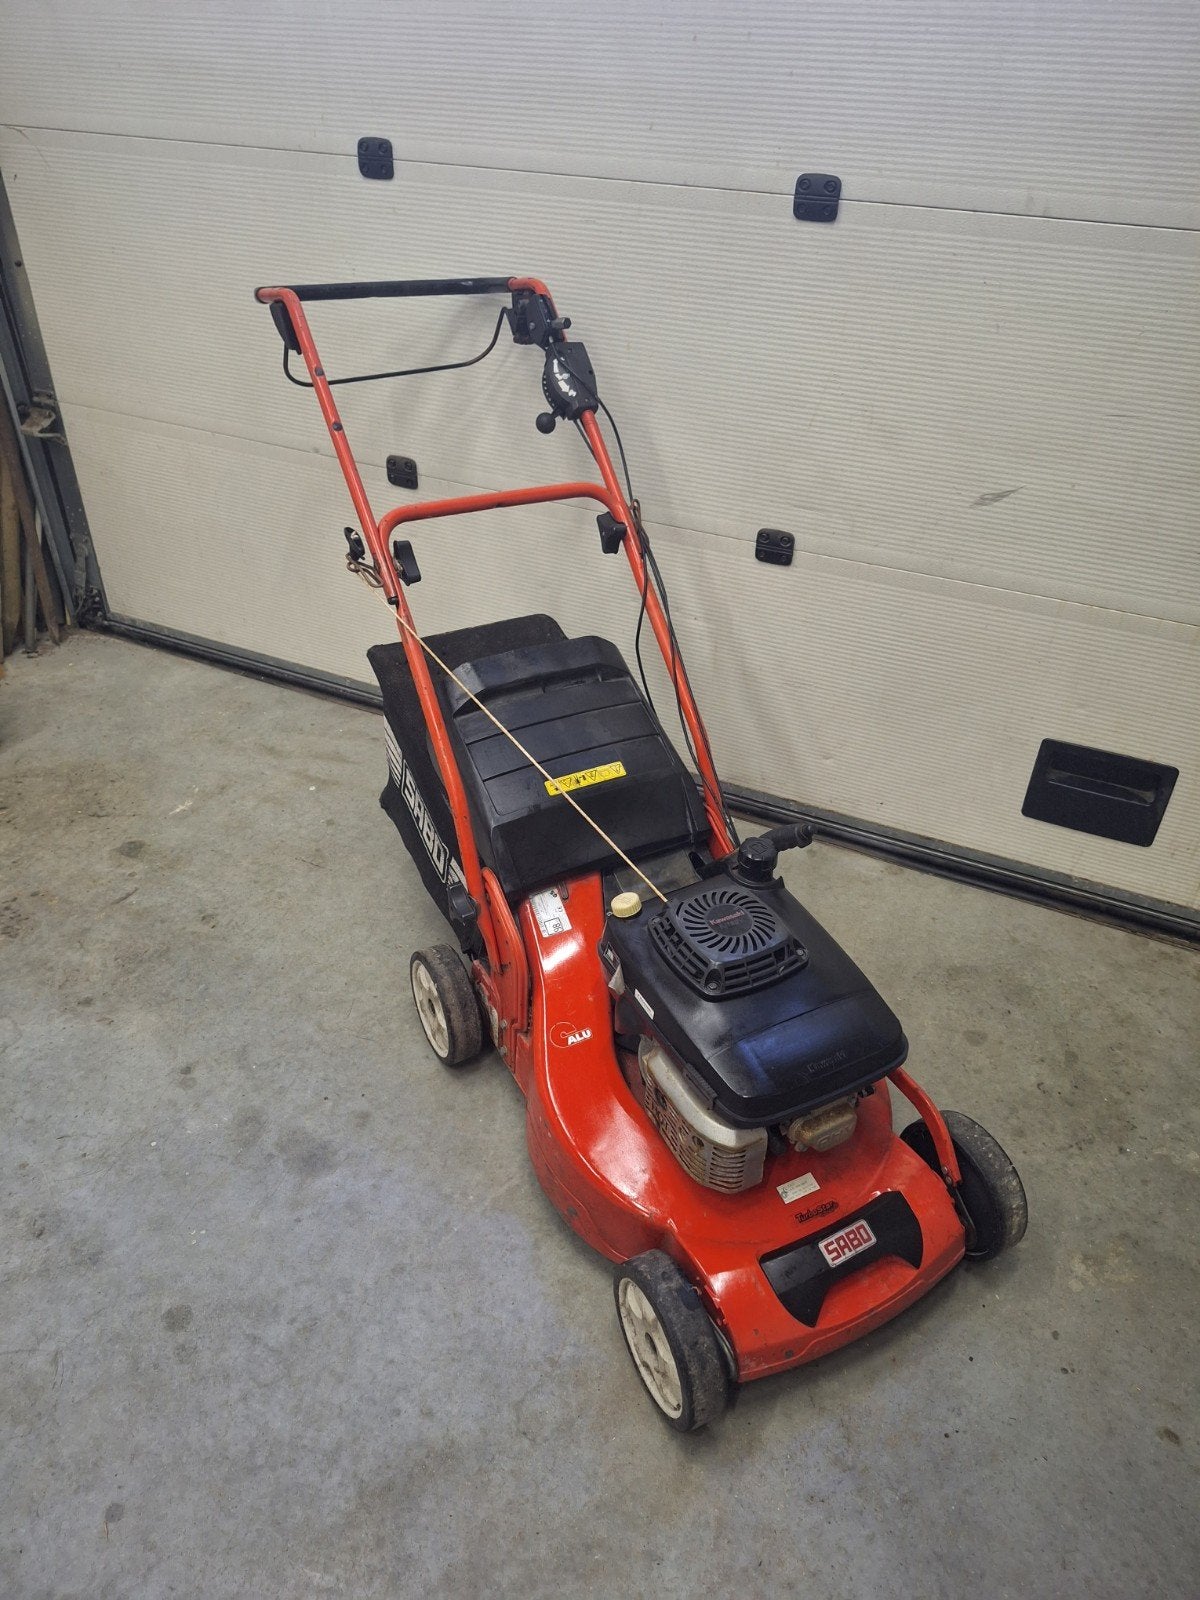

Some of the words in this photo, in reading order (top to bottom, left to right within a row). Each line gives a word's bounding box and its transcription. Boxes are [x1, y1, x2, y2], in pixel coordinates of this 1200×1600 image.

[403, 767, 447, 877] SABO
[568, 1029, 591, 1046] ALU
[824, 1223, 873, 1262] SABO
